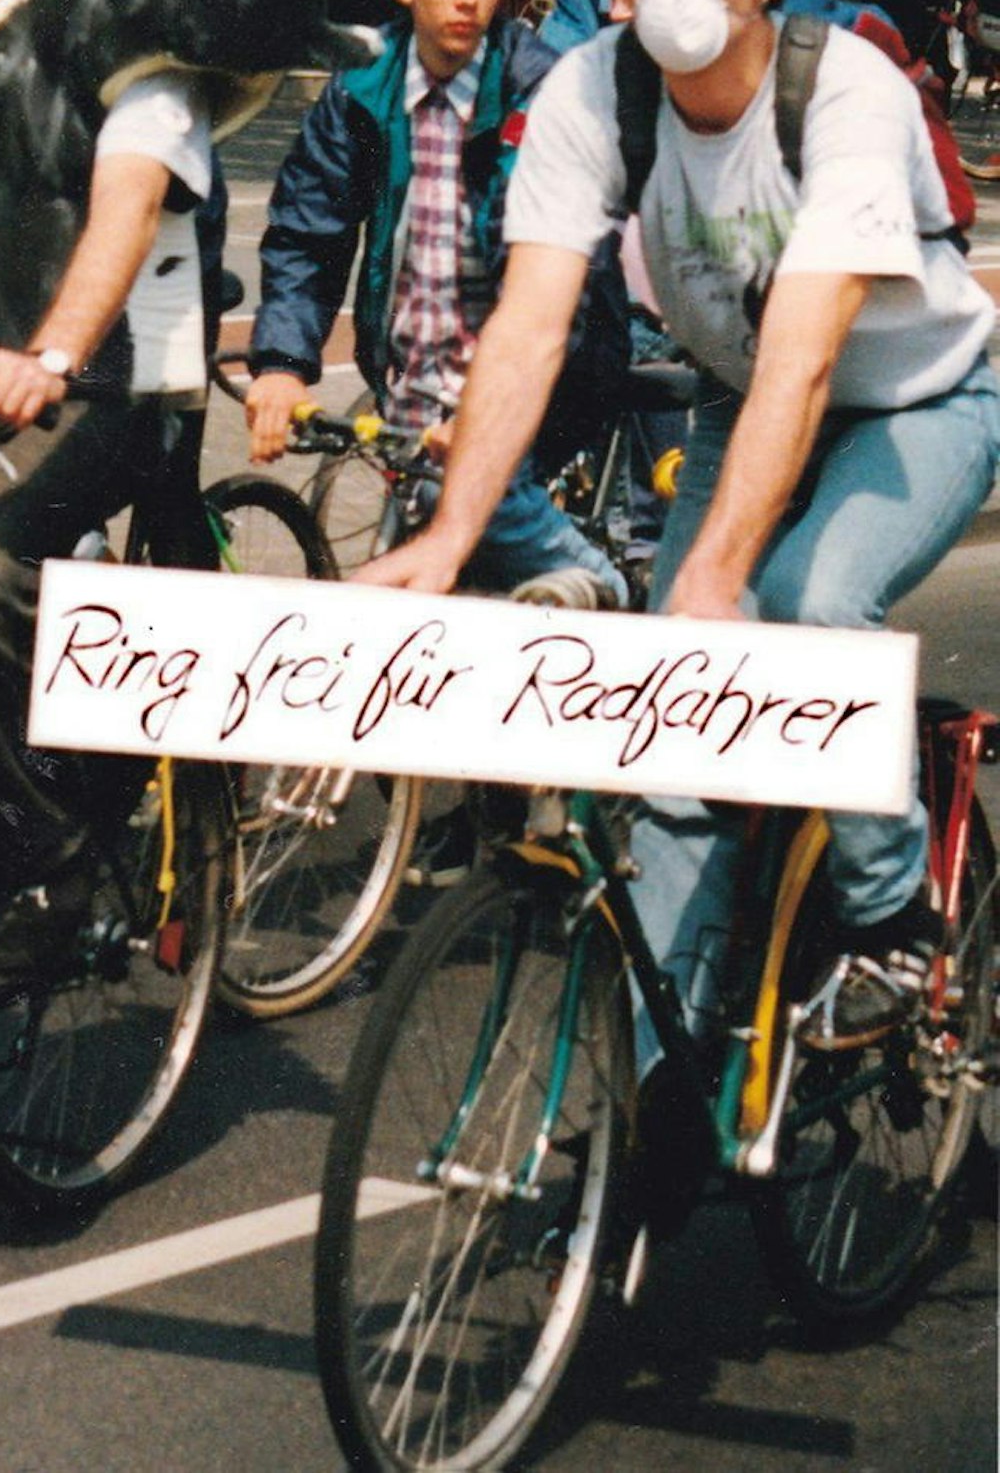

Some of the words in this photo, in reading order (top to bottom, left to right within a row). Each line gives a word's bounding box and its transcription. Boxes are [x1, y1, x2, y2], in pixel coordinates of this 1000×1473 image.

[45, 604, 202, 742] Ring
[220, 612, 354, 740] frei
[351, 620, 474, 742] für
[503, 633, 880, 768] Radfahrer
